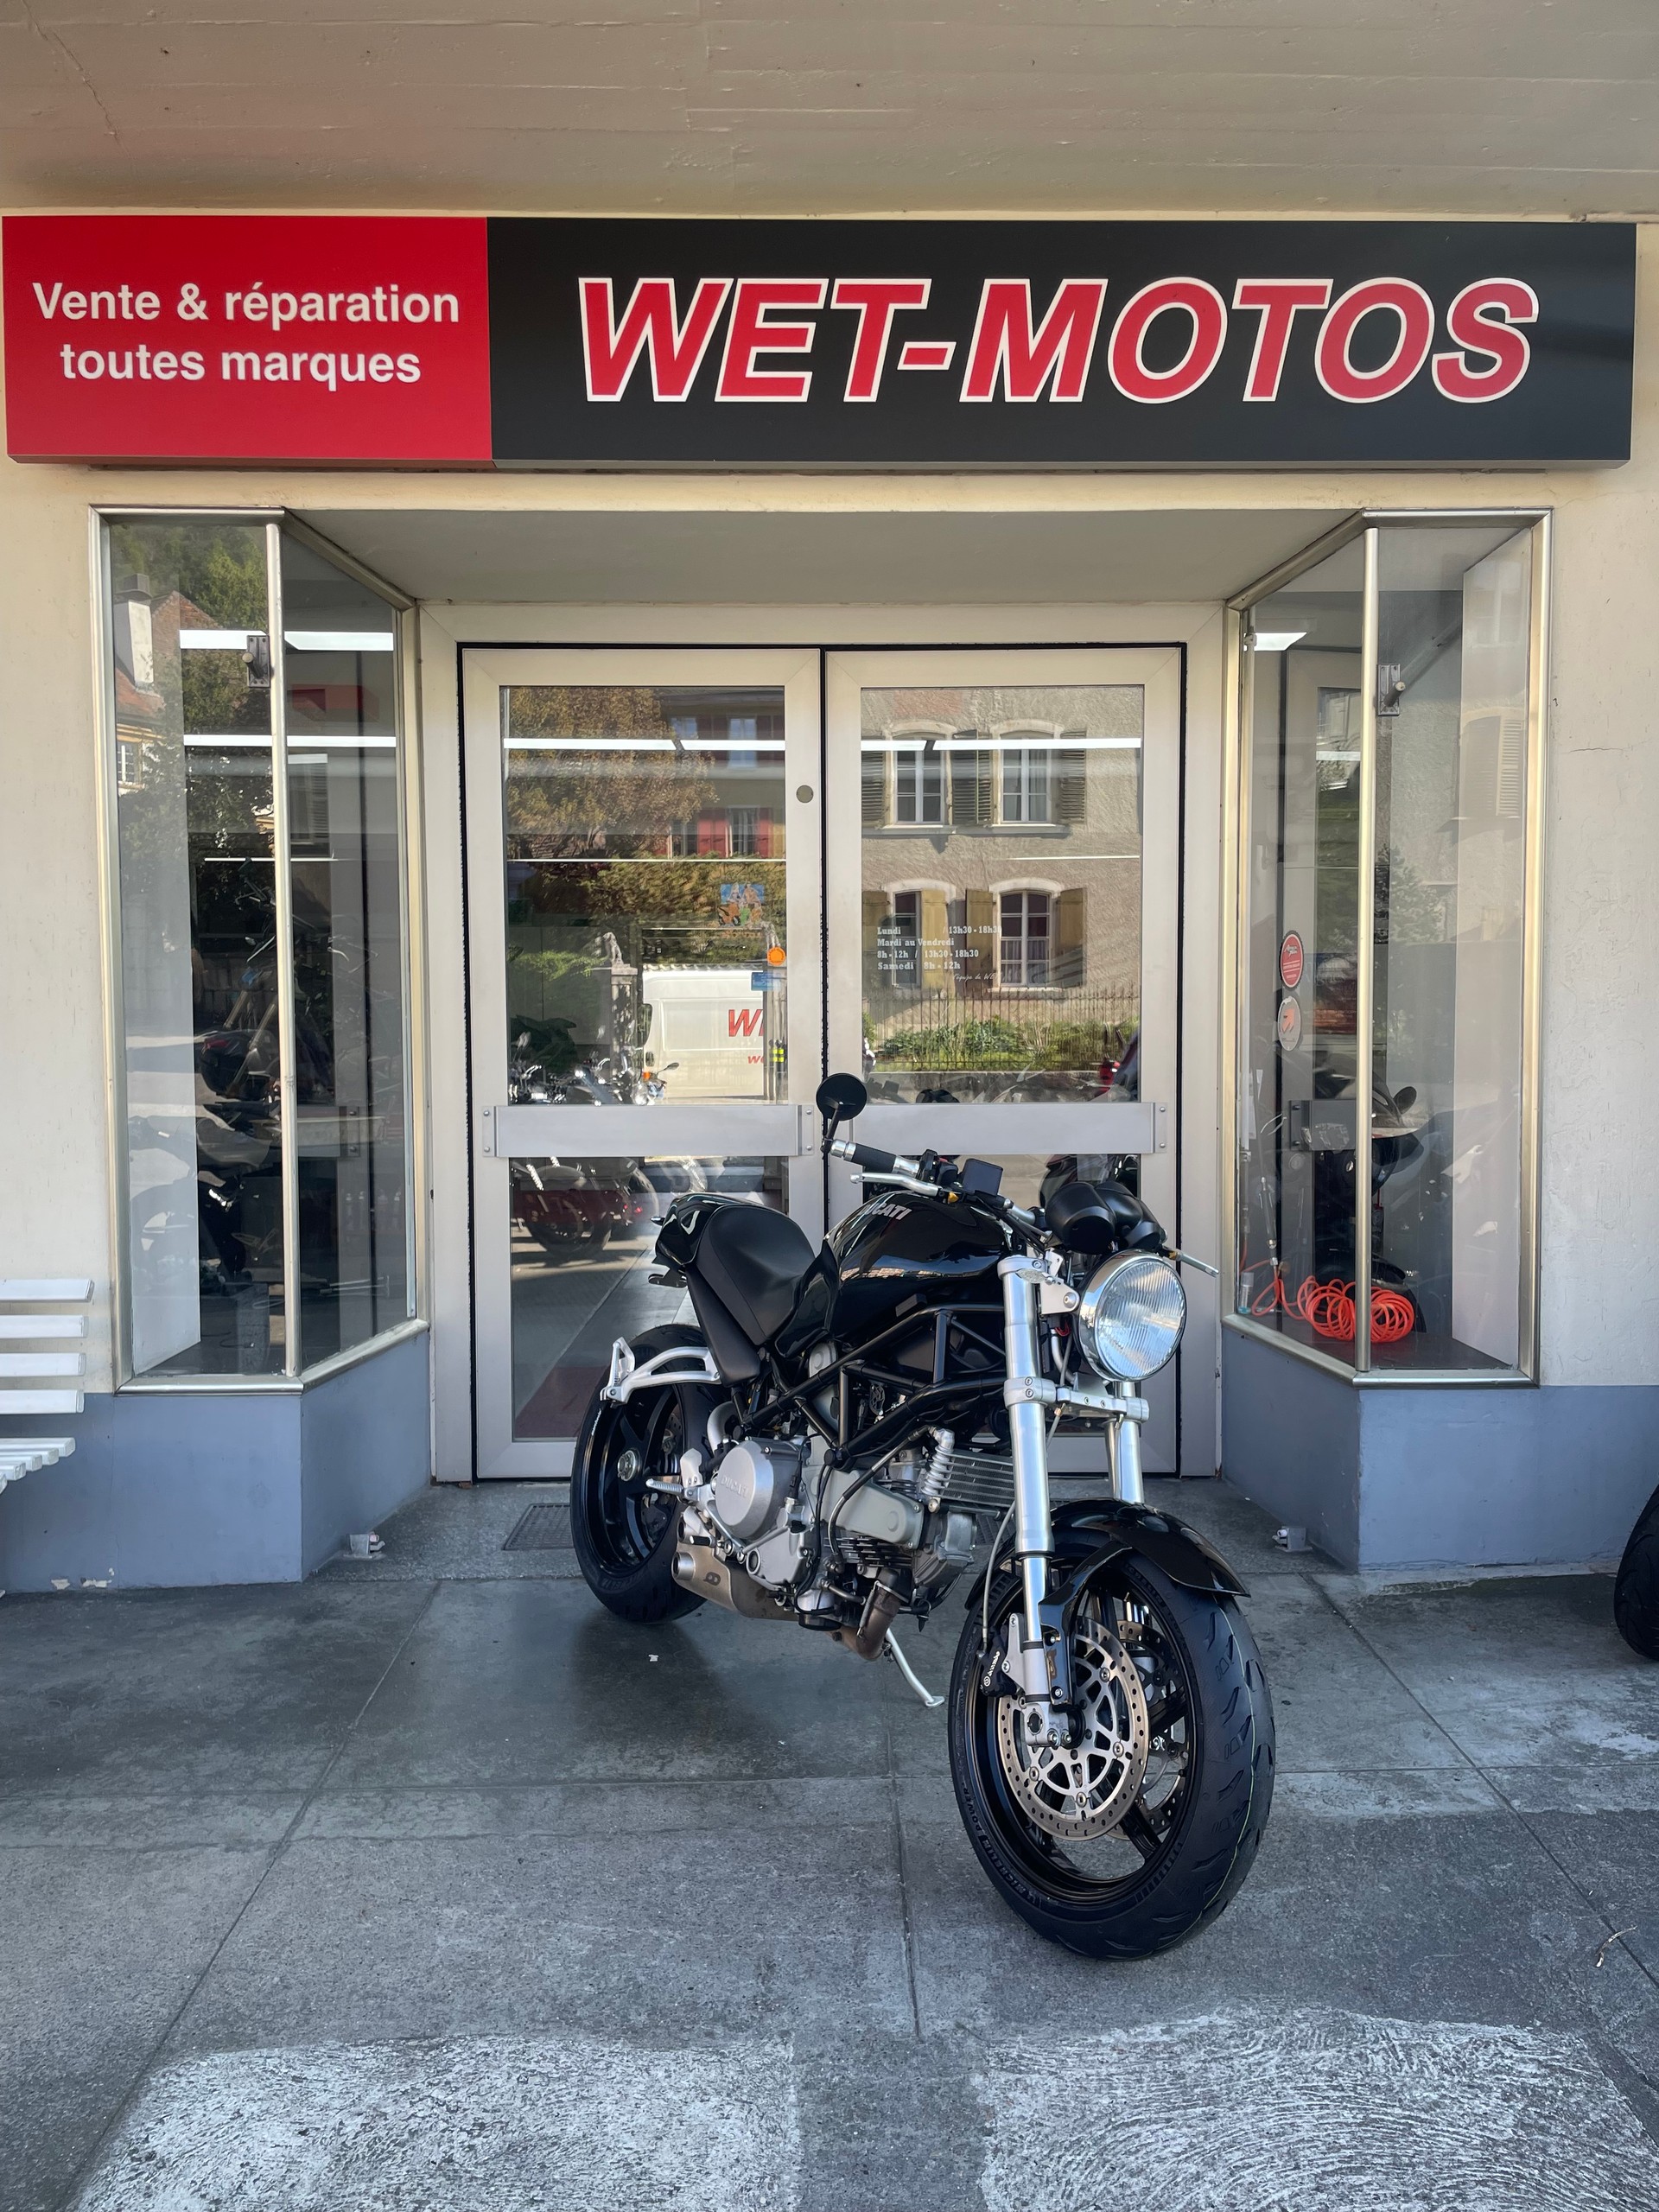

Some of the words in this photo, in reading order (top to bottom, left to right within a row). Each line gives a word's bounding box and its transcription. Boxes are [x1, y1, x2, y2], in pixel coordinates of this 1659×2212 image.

[32, 281, 160, 321] Vente
[176, 283, 208, 321] &
[224, 280, 460, 330] réparation
[578, 276, 1539, 404] WET-MOTOS
[60, 344, 205, 380] toutes
[221, 349, 422, 391] marques
[949, 925, 971, 934] 13h30
[877, 938, 901, 947] Mardi
[918, 938, 954, 946] Vendredi
[893, 950, 908, 958] 12h
[955, 949, 979, 957] 18h30
[943, 961, 960, 969] 12h
[728, 1009, 763, 1037] W
